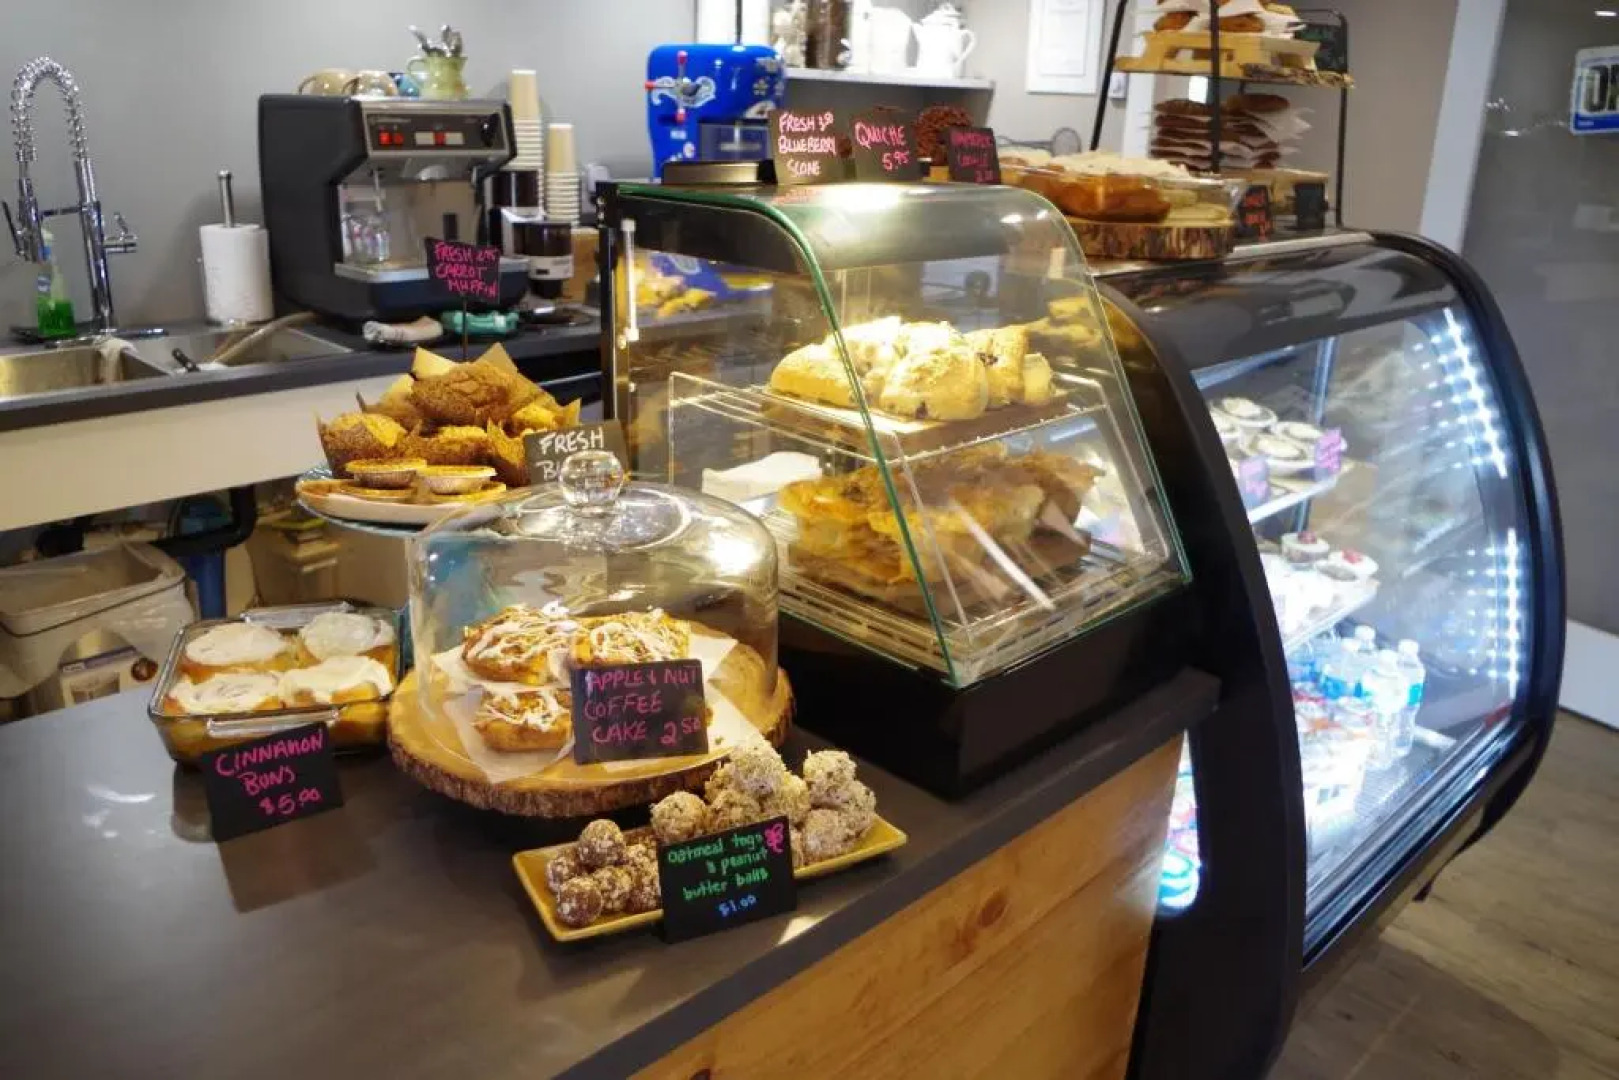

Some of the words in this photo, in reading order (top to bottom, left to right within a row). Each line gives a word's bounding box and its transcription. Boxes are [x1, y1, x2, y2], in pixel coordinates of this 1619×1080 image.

[779, 111, 815, 132] FRESH
[854, 121, 905, 149] QUICHE
[434, 241, 473, 262] FRESH
[436, 263, 488, 280] CARROT
[447, 279, 498, 299] MUFFIN
[538, 427, 604, 454] FRESH
[585, 670, 645, 695] APPLE
[664, 667, 697, 689] NUT
[584, 690, 661, 720] COFFEE
[592, 720, 646, 744] CAKE
[216, 729, 323, 775] CINNAMON
[238, 765, 296, 795] BUNS
[721, 847, 767, 875] peanut
[682, 880, 727, 900] butter
[736, 867, 769, 886] balls
